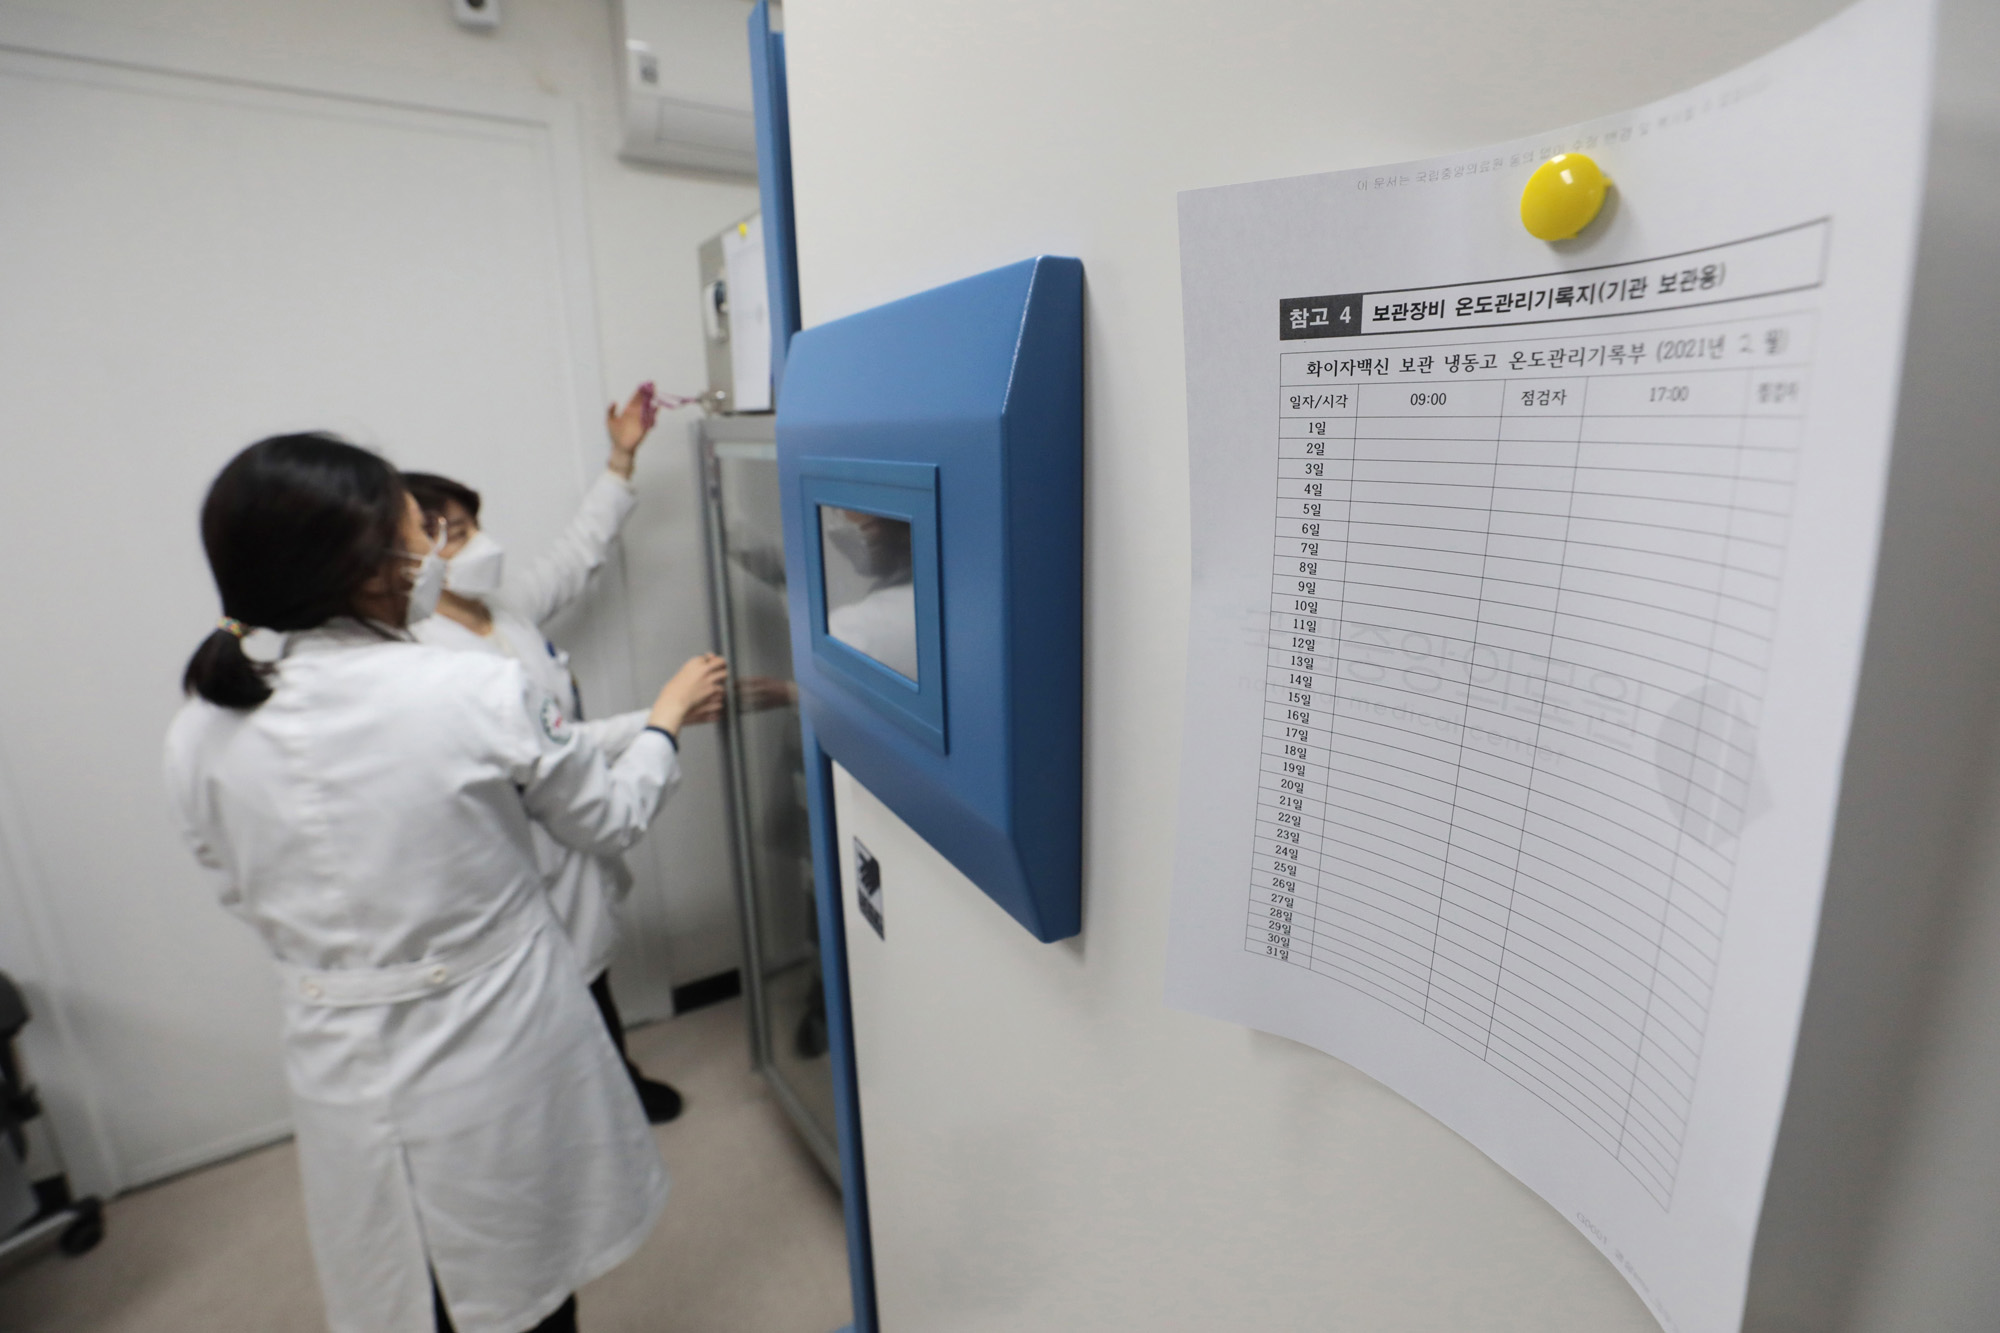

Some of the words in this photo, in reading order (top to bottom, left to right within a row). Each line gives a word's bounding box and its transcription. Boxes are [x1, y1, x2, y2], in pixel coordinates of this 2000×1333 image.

[1356, 178, 1368, 192] 이
[1374, 174, 1411, 190] 문서는
[1415, 157, 1504, 183] 국립중앙의료원
[1509, 150, 1534, 168] 동의
[1289, 306, 1330, 329] 참고
[1339, 305, 1352, 324] 4
[1372, 299, 1446, 322] 보관장비
[1454, 275, 1648, 317] 온도관리기록지(기관
[1657, 261, 1727, 295] 보관용)
[1306, 357, 1390, 378] 화이자백신
[1399, 355, 1435, 375] 보관
[1444, 353, 1498, 373] 냉동고
[1507, 342, 1648, 371] 온도관리기록부
[1656, 334, 1726, 363] (2021년
[1289, 393, 1349, 410] 일자/시각
[1410, 392, 1447, 406] 09:00
[1520, 388, 1568, 407] 점검자
[1649, 385, 1690, 403] 17:00
[1308, 421, 1326, 435] 1일
[1306, 442, 1325, 456] 2일
[1305, 462, 1324, 476] 3일
[1304, 483, 1322, 496] 4일
[1303, 503, 1321, 517] 5일
[1301, 523, 1320, 536] 6일
[1301, 542, 1319, 556] 7일
[1299, 562, 1317, 575] 8일
[1298, 581, 1316, 595] 9일
[1295, 600, 1318, 614] 10일
[1293, 618, 1317, 633] 11일
[1292, 637, 1315, 652] 12일
[1291, 655, 1314, 670] 13일
[1289, 674, 1312, 688] 14일
[1288, 691, 1311, 707] 15일
[1287, 709, 1310, 724] 16일
[1285, 727, 1308, 742] 17일
[1284, 744, 1307, 760] 18일
[1283, 761, 1305, 777] 19일
[1281, 778, 1304, 794] 20일
[1279, 795, 1302, 811] 21일
[1278, 812, 1301, 827] 22일
[1276, 828, 1300, 844] 23일
[1275, 844, 1298, 860] 24일
[1273, 861, 1297, 877] 25일
[1272, 877, 1296, 893] 26일
[1271, 893, 1294, 909] 27일
[1269, 907, 1293, 923] 28일
[1268, 920, 1292, 936] 29일
[1267, 932, 1290, 949] 30일
[1266, 945, 1289, 961] 31일
